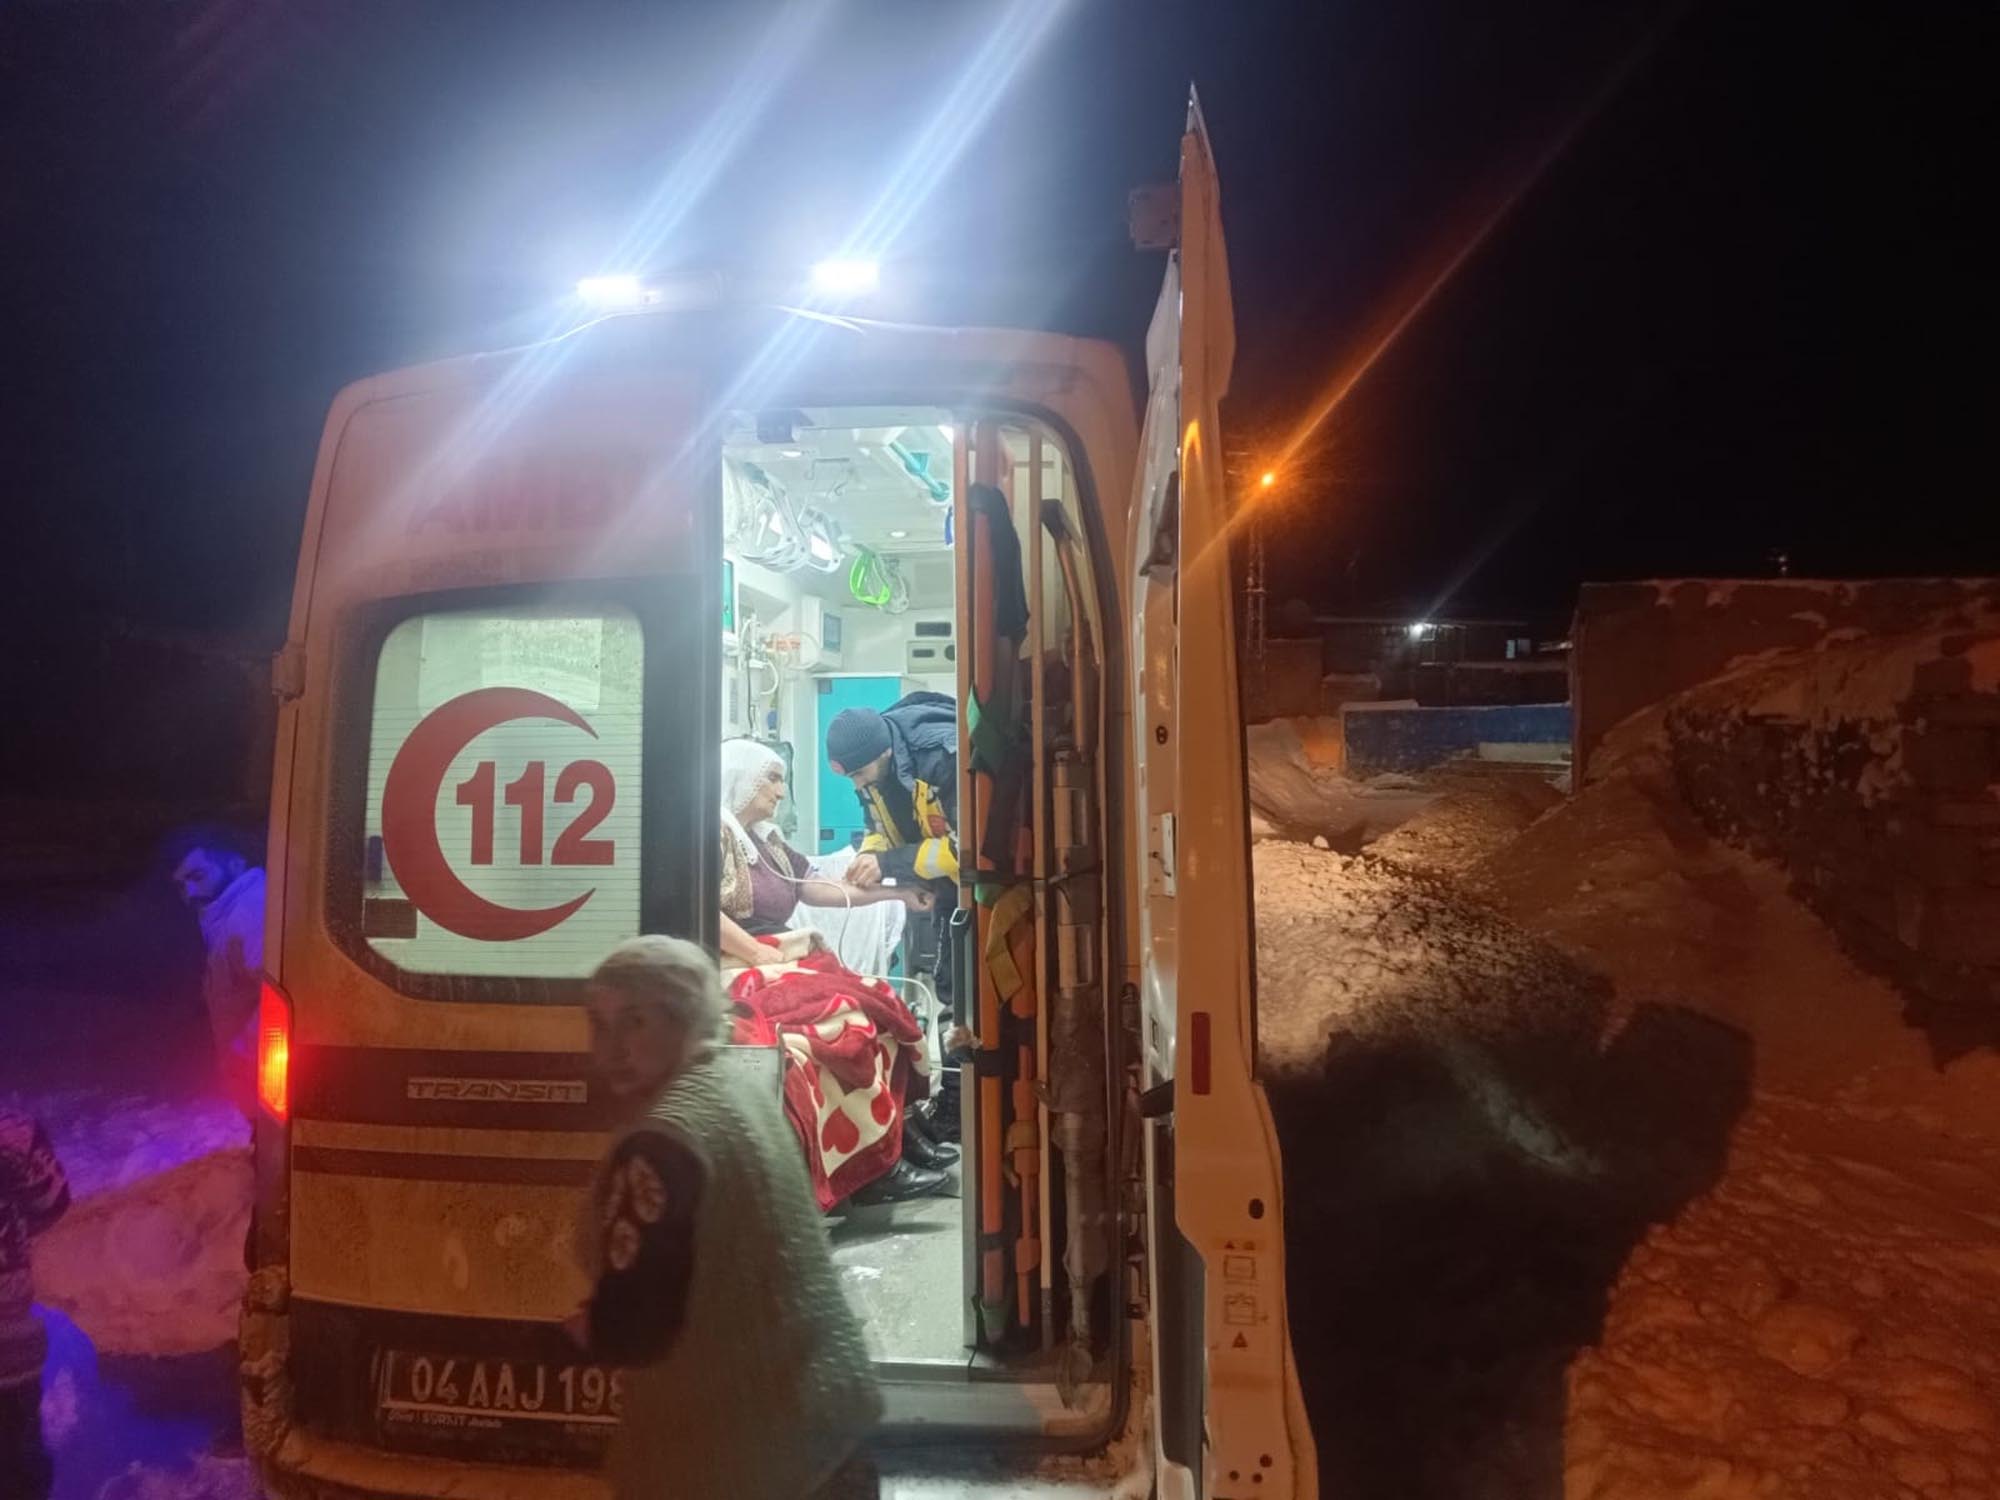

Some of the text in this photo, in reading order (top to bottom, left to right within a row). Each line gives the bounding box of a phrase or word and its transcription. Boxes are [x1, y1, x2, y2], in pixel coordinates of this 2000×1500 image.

[455, 759, 616, 866] 112
[408, 1077, 587, 1102] TRANSIT
[411, 1356, 459, 1402] 04
[467, 1361, 545, 1411] AAJ
